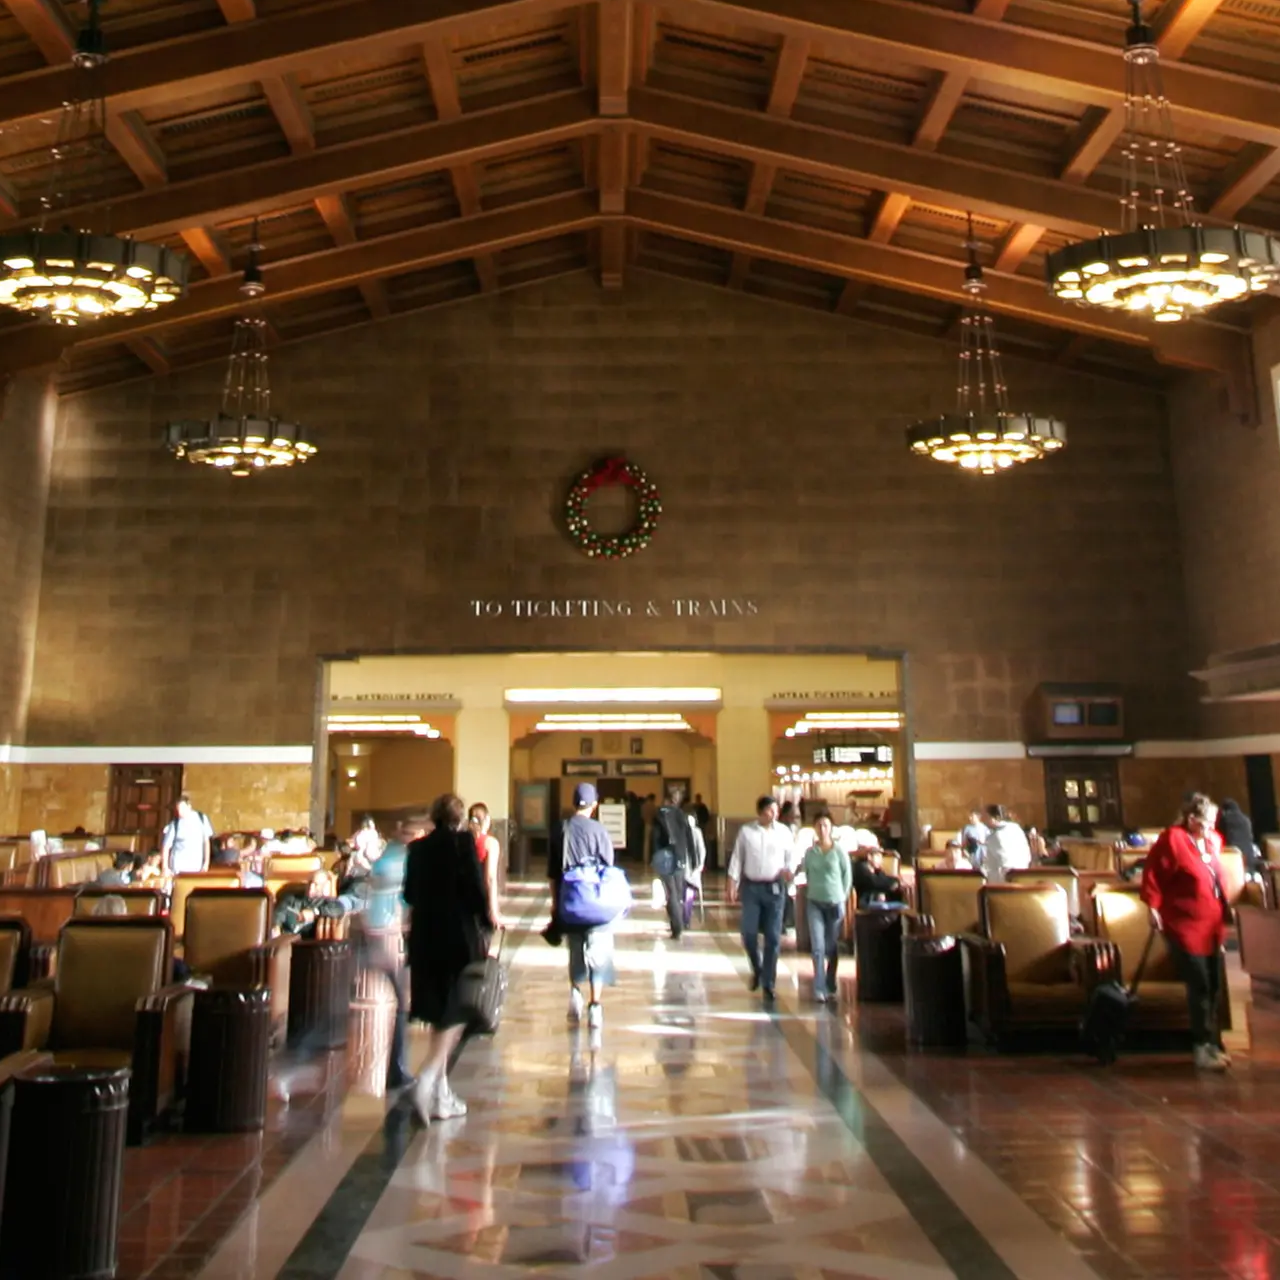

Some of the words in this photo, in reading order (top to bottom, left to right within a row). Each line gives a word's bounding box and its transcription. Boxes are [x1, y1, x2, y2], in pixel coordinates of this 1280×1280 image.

[470, 599, 503, 617] TO
[511, 599, 632, 618] TICKETING
[646, 600, 661, 617] &
[672, 599, 759, 617] TRAINS
